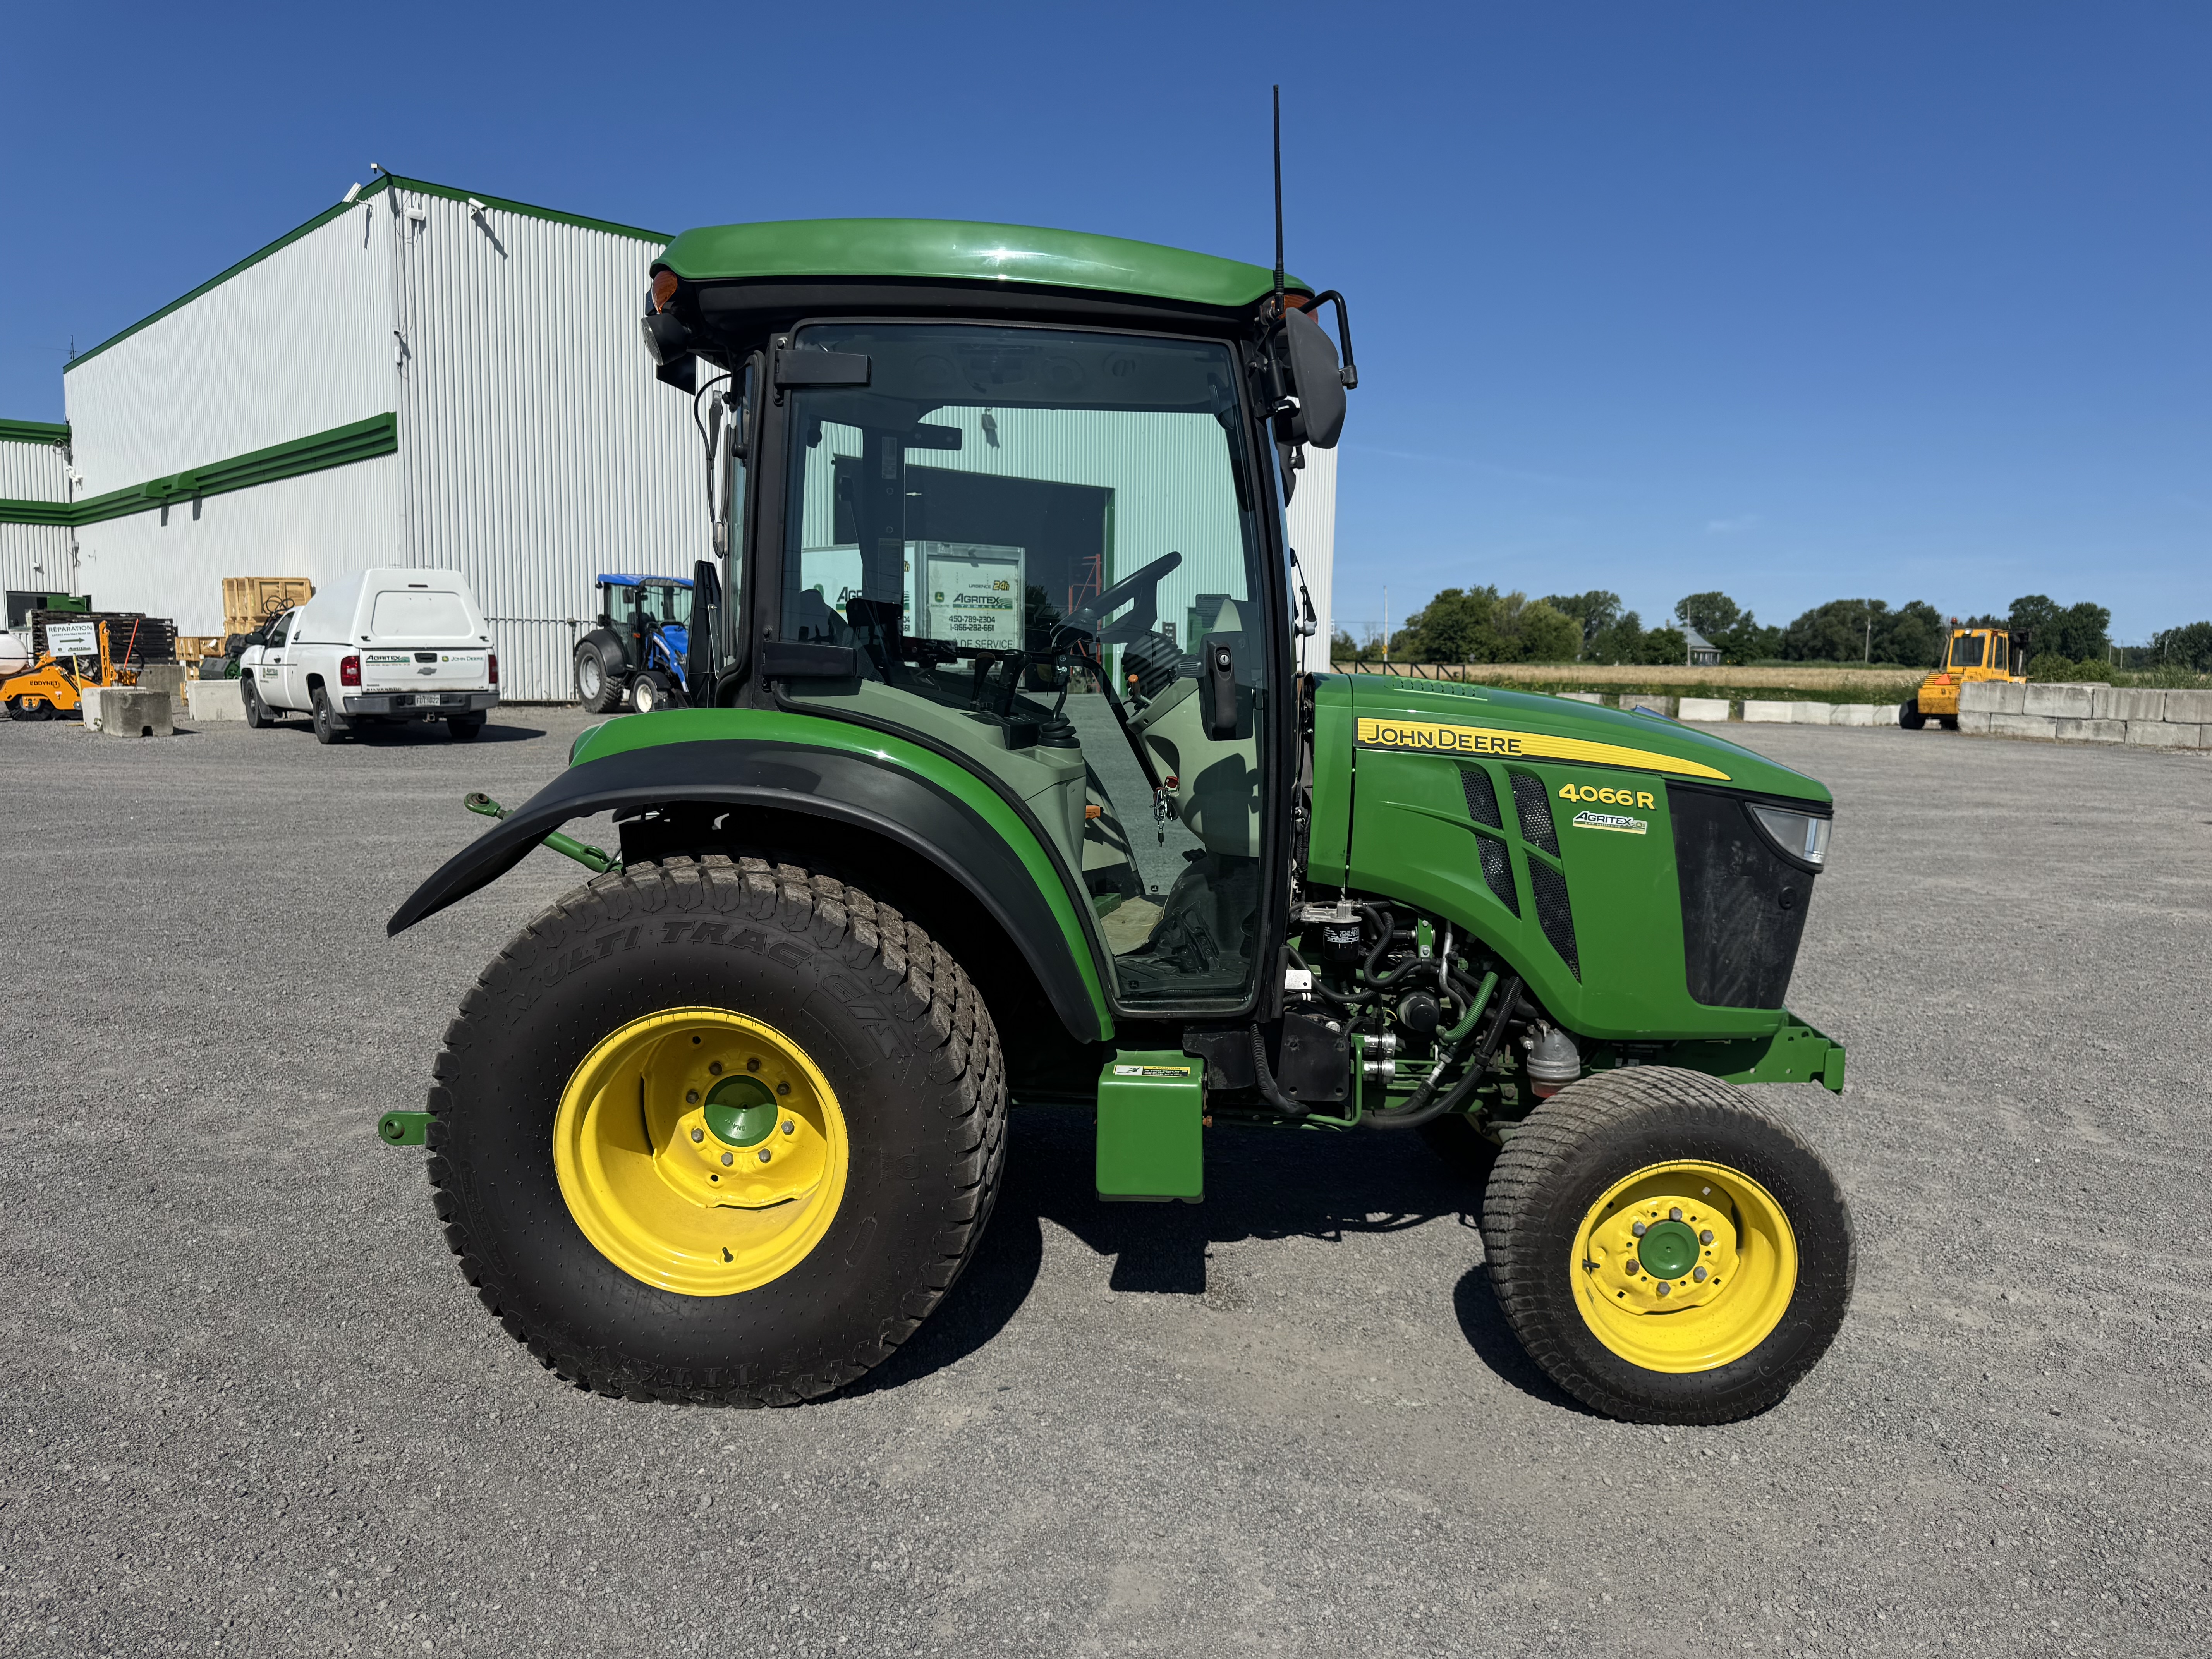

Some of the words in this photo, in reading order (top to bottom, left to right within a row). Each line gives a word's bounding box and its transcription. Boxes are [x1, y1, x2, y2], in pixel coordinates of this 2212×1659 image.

[993, 580, 1010, 591] 24h
[953, 593, 1000, 604] AGRITEX
[975, 640, 1013, 649] SERVICE
[1367, 724, 1433, 745] JOHN
[1438, 729, 1522, 753] DEERE
[1559, 783, 1634, 807] 4066
[1636, 791, 1656, 810] R
[1575, 812, 1632, 826] AGRITEX
[660, 920, 814, 969] TRAC
